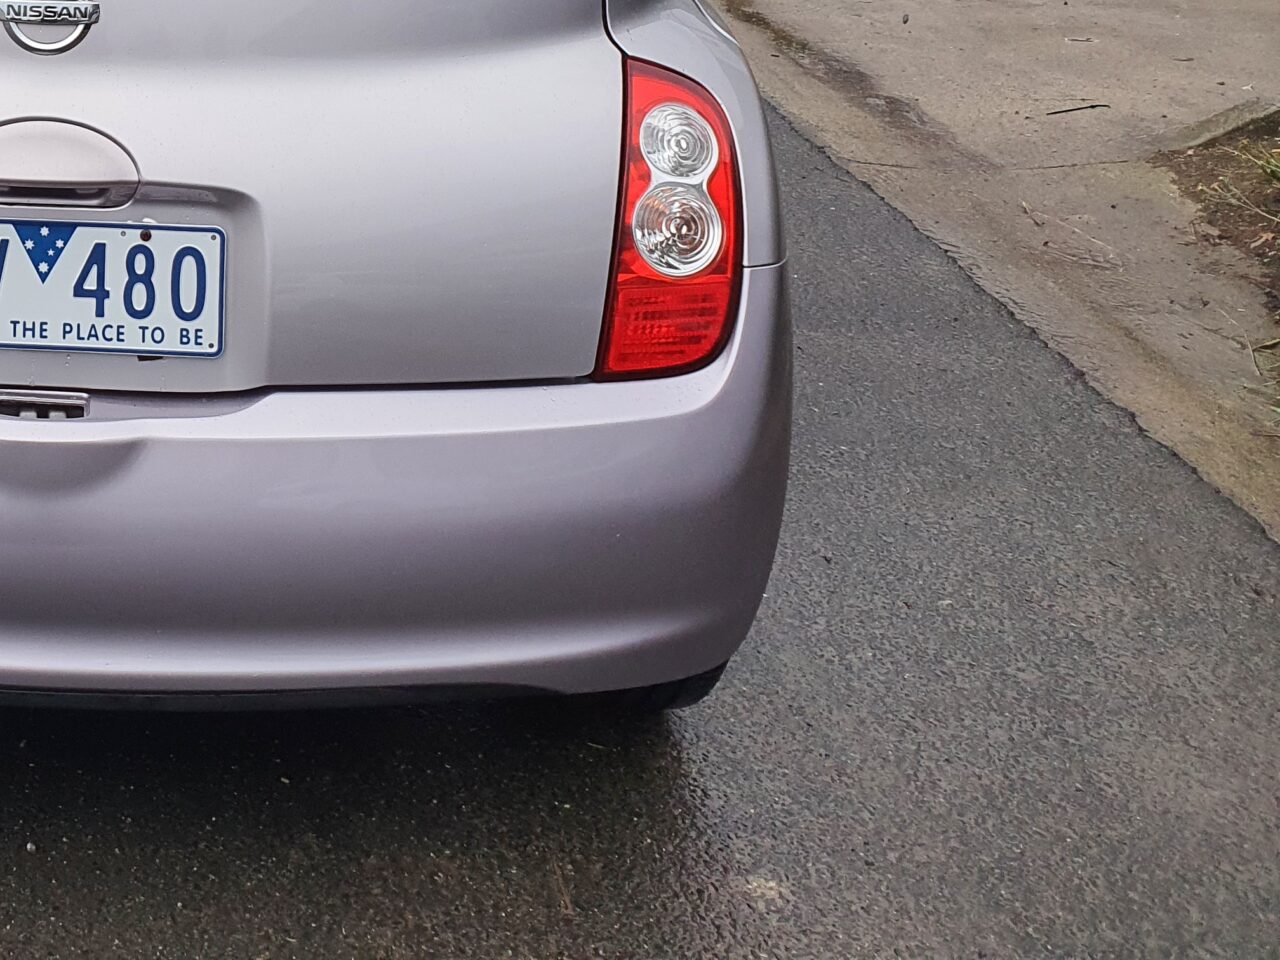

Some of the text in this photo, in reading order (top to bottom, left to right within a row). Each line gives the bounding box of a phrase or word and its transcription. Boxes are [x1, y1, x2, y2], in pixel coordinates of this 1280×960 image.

[6, 4, 89, 19] NISSAN
[73, 241, 208, 322] 480
[10, 320, 49, 339] THE
[62, 323, 125, 342] PLACE
[139, 326, 165, 344] TO
[180, 328, 204, 346] BE
